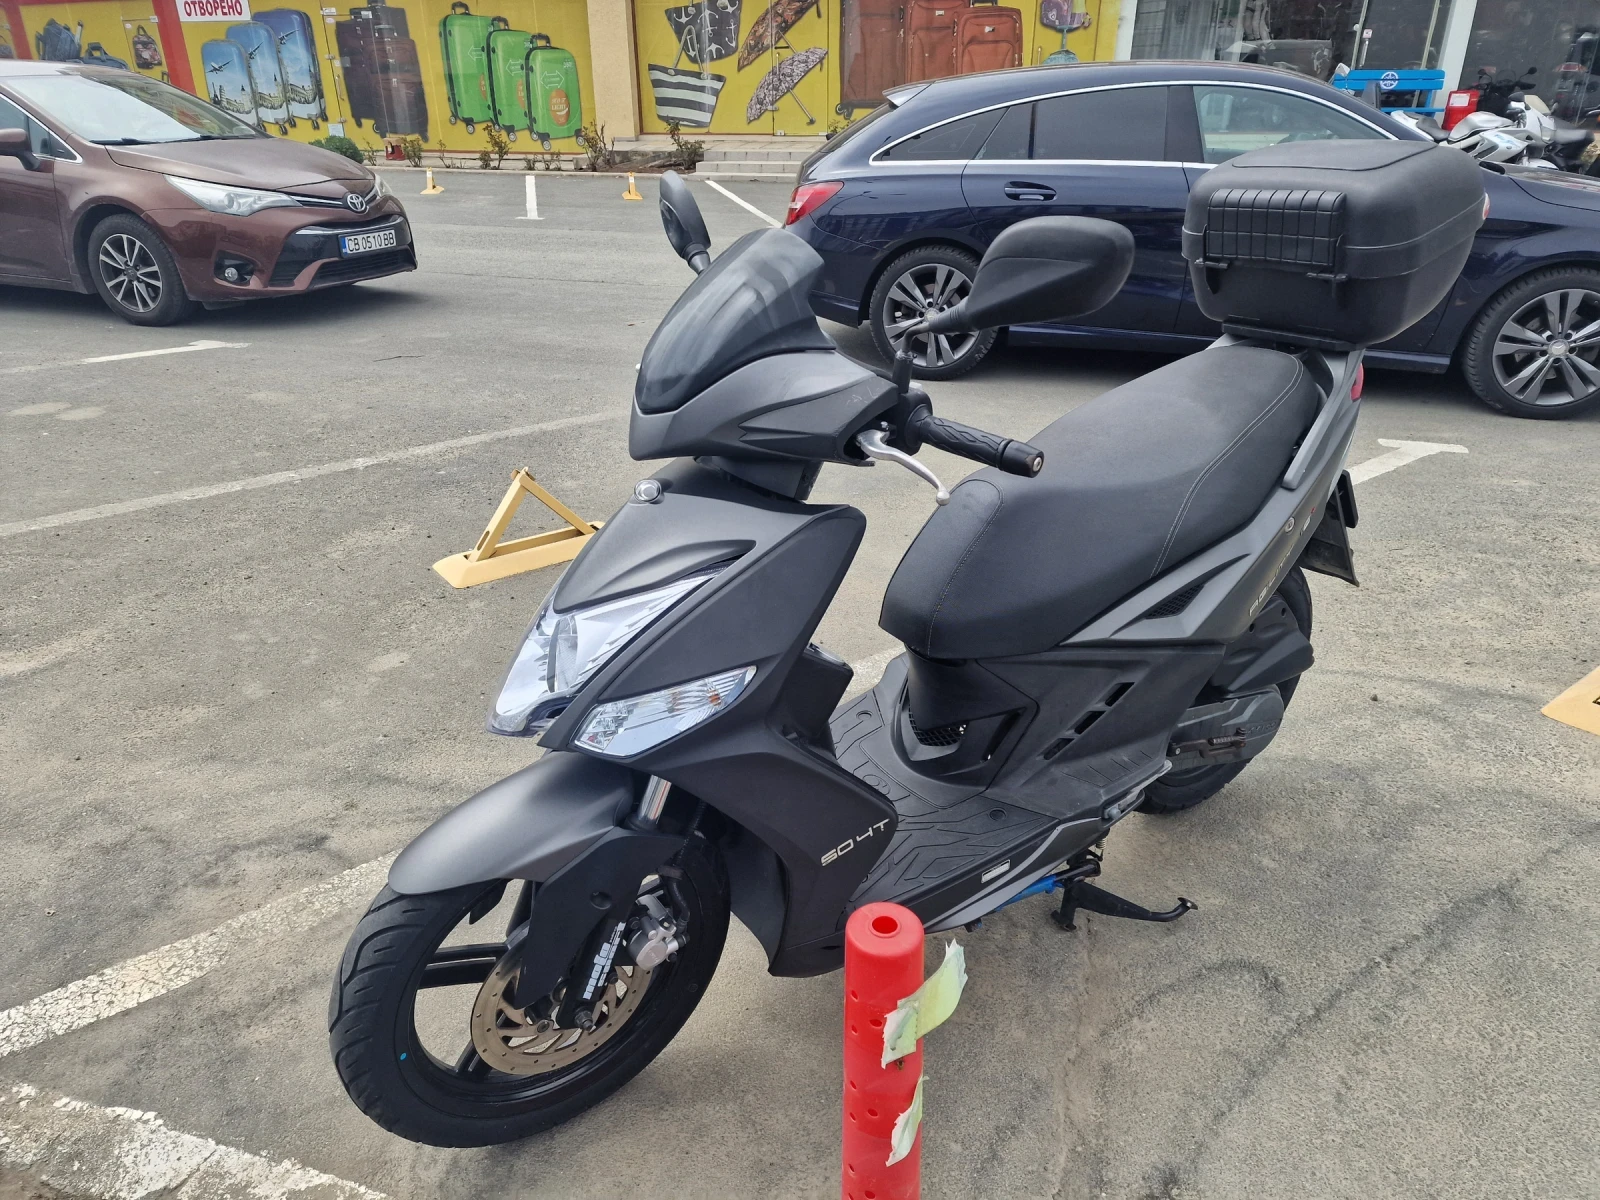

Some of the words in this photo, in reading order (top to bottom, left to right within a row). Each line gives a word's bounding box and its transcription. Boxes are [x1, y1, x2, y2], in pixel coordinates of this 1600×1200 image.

[184, 0, 243, 17] ОТВОРЕНО
[347, 238, 360, 252] CB
[361, 234, 383, 250] 0510
[383, 232, 395, 246] BB
[820, 841, 854, 867] 50
[856, 818, 890, 843] 4T
